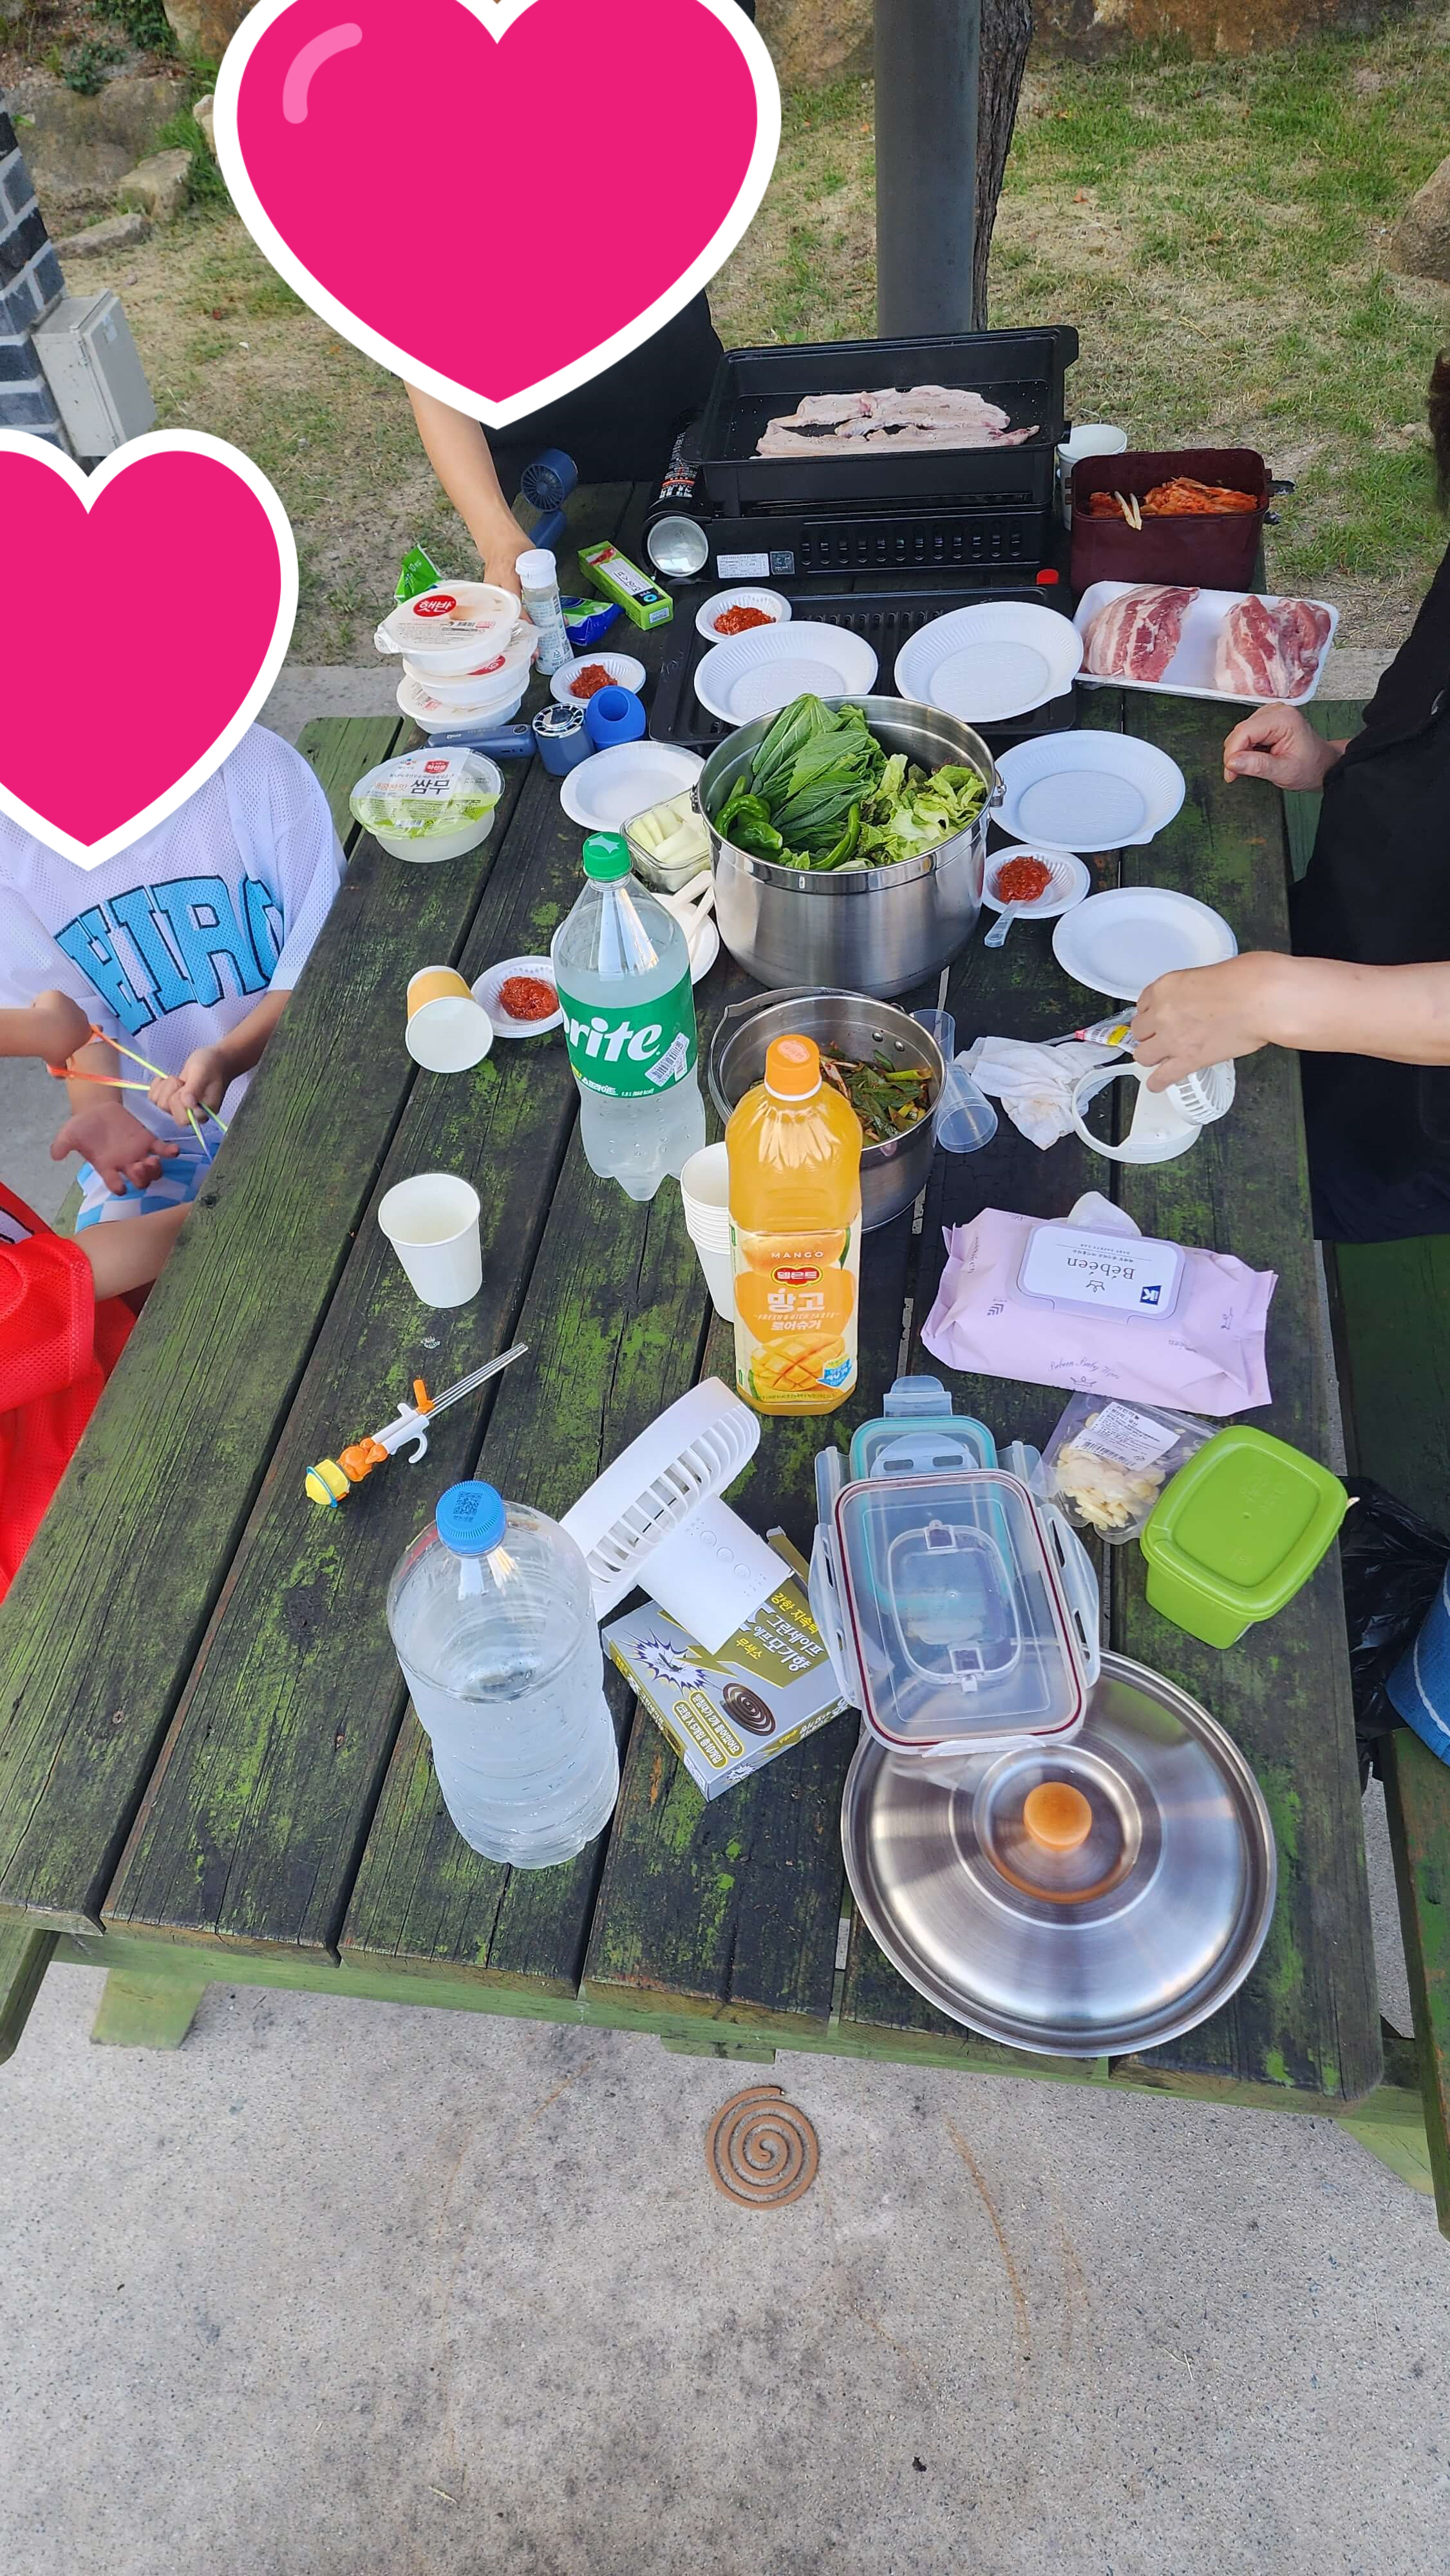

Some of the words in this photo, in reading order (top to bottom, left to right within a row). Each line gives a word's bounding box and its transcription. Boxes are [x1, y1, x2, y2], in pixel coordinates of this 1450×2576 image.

[417, 600, 453, 612] 햇반
[410, 779, 450, 795] 쌈무
[767, 1288, 825, 1314] 망고
[771, 1320, 822, 1331] 로어슈거
[771, 1592, 796, 1612] 강한
[766, 1615, 825, 1658] 그린세이프
[736, 1637, 762, 1660] 무색소
[675, 1702, 692, 1721] 2코일
[690, 1722, 706, 1741] 5개입
[692, 1692, 713, 1718] 받침대가
[714, 1723, 740, 1754] 들어있어요
